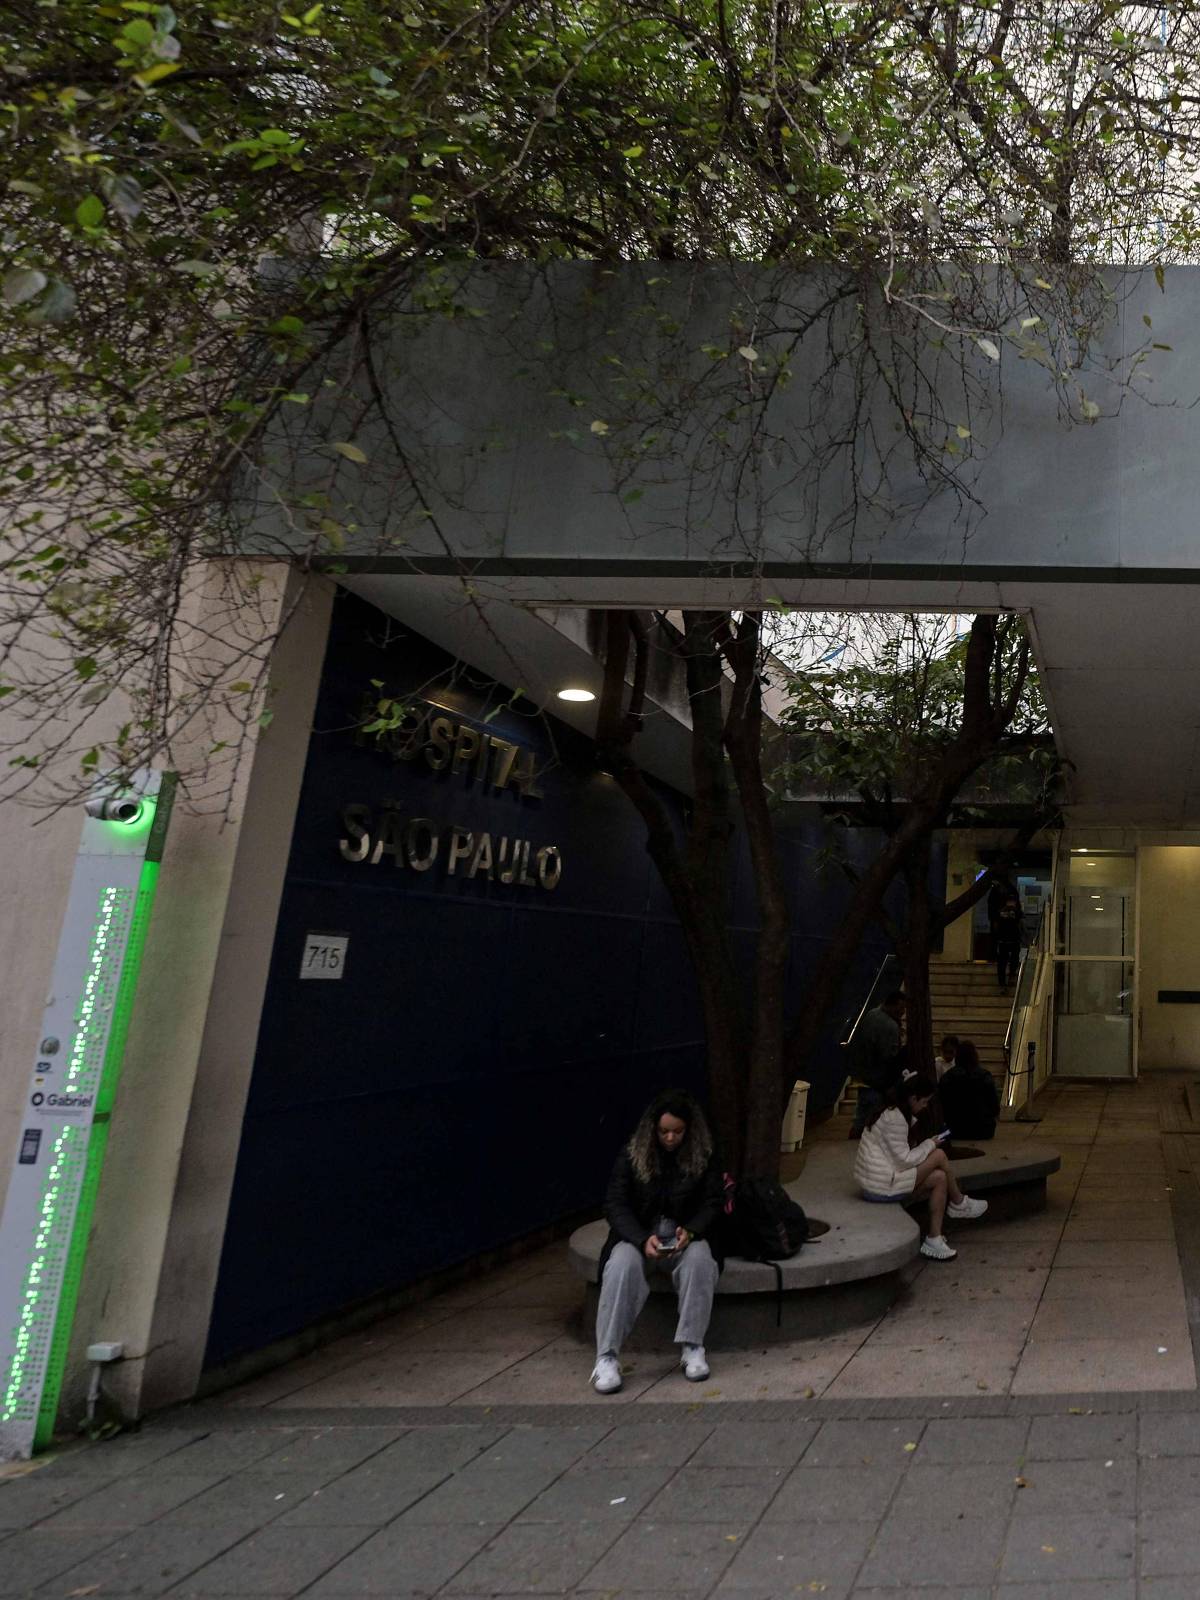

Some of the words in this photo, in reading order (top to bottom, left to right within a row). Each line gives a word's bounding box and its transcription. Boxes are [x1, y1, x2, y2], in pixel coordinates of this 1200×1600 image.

[339, 798, 439, 872] SÃO
[448, 824, 562, 891] PAULO
[308, 945, 341, 969] 715
[47, 1093, 94, 1107] Gabriel
